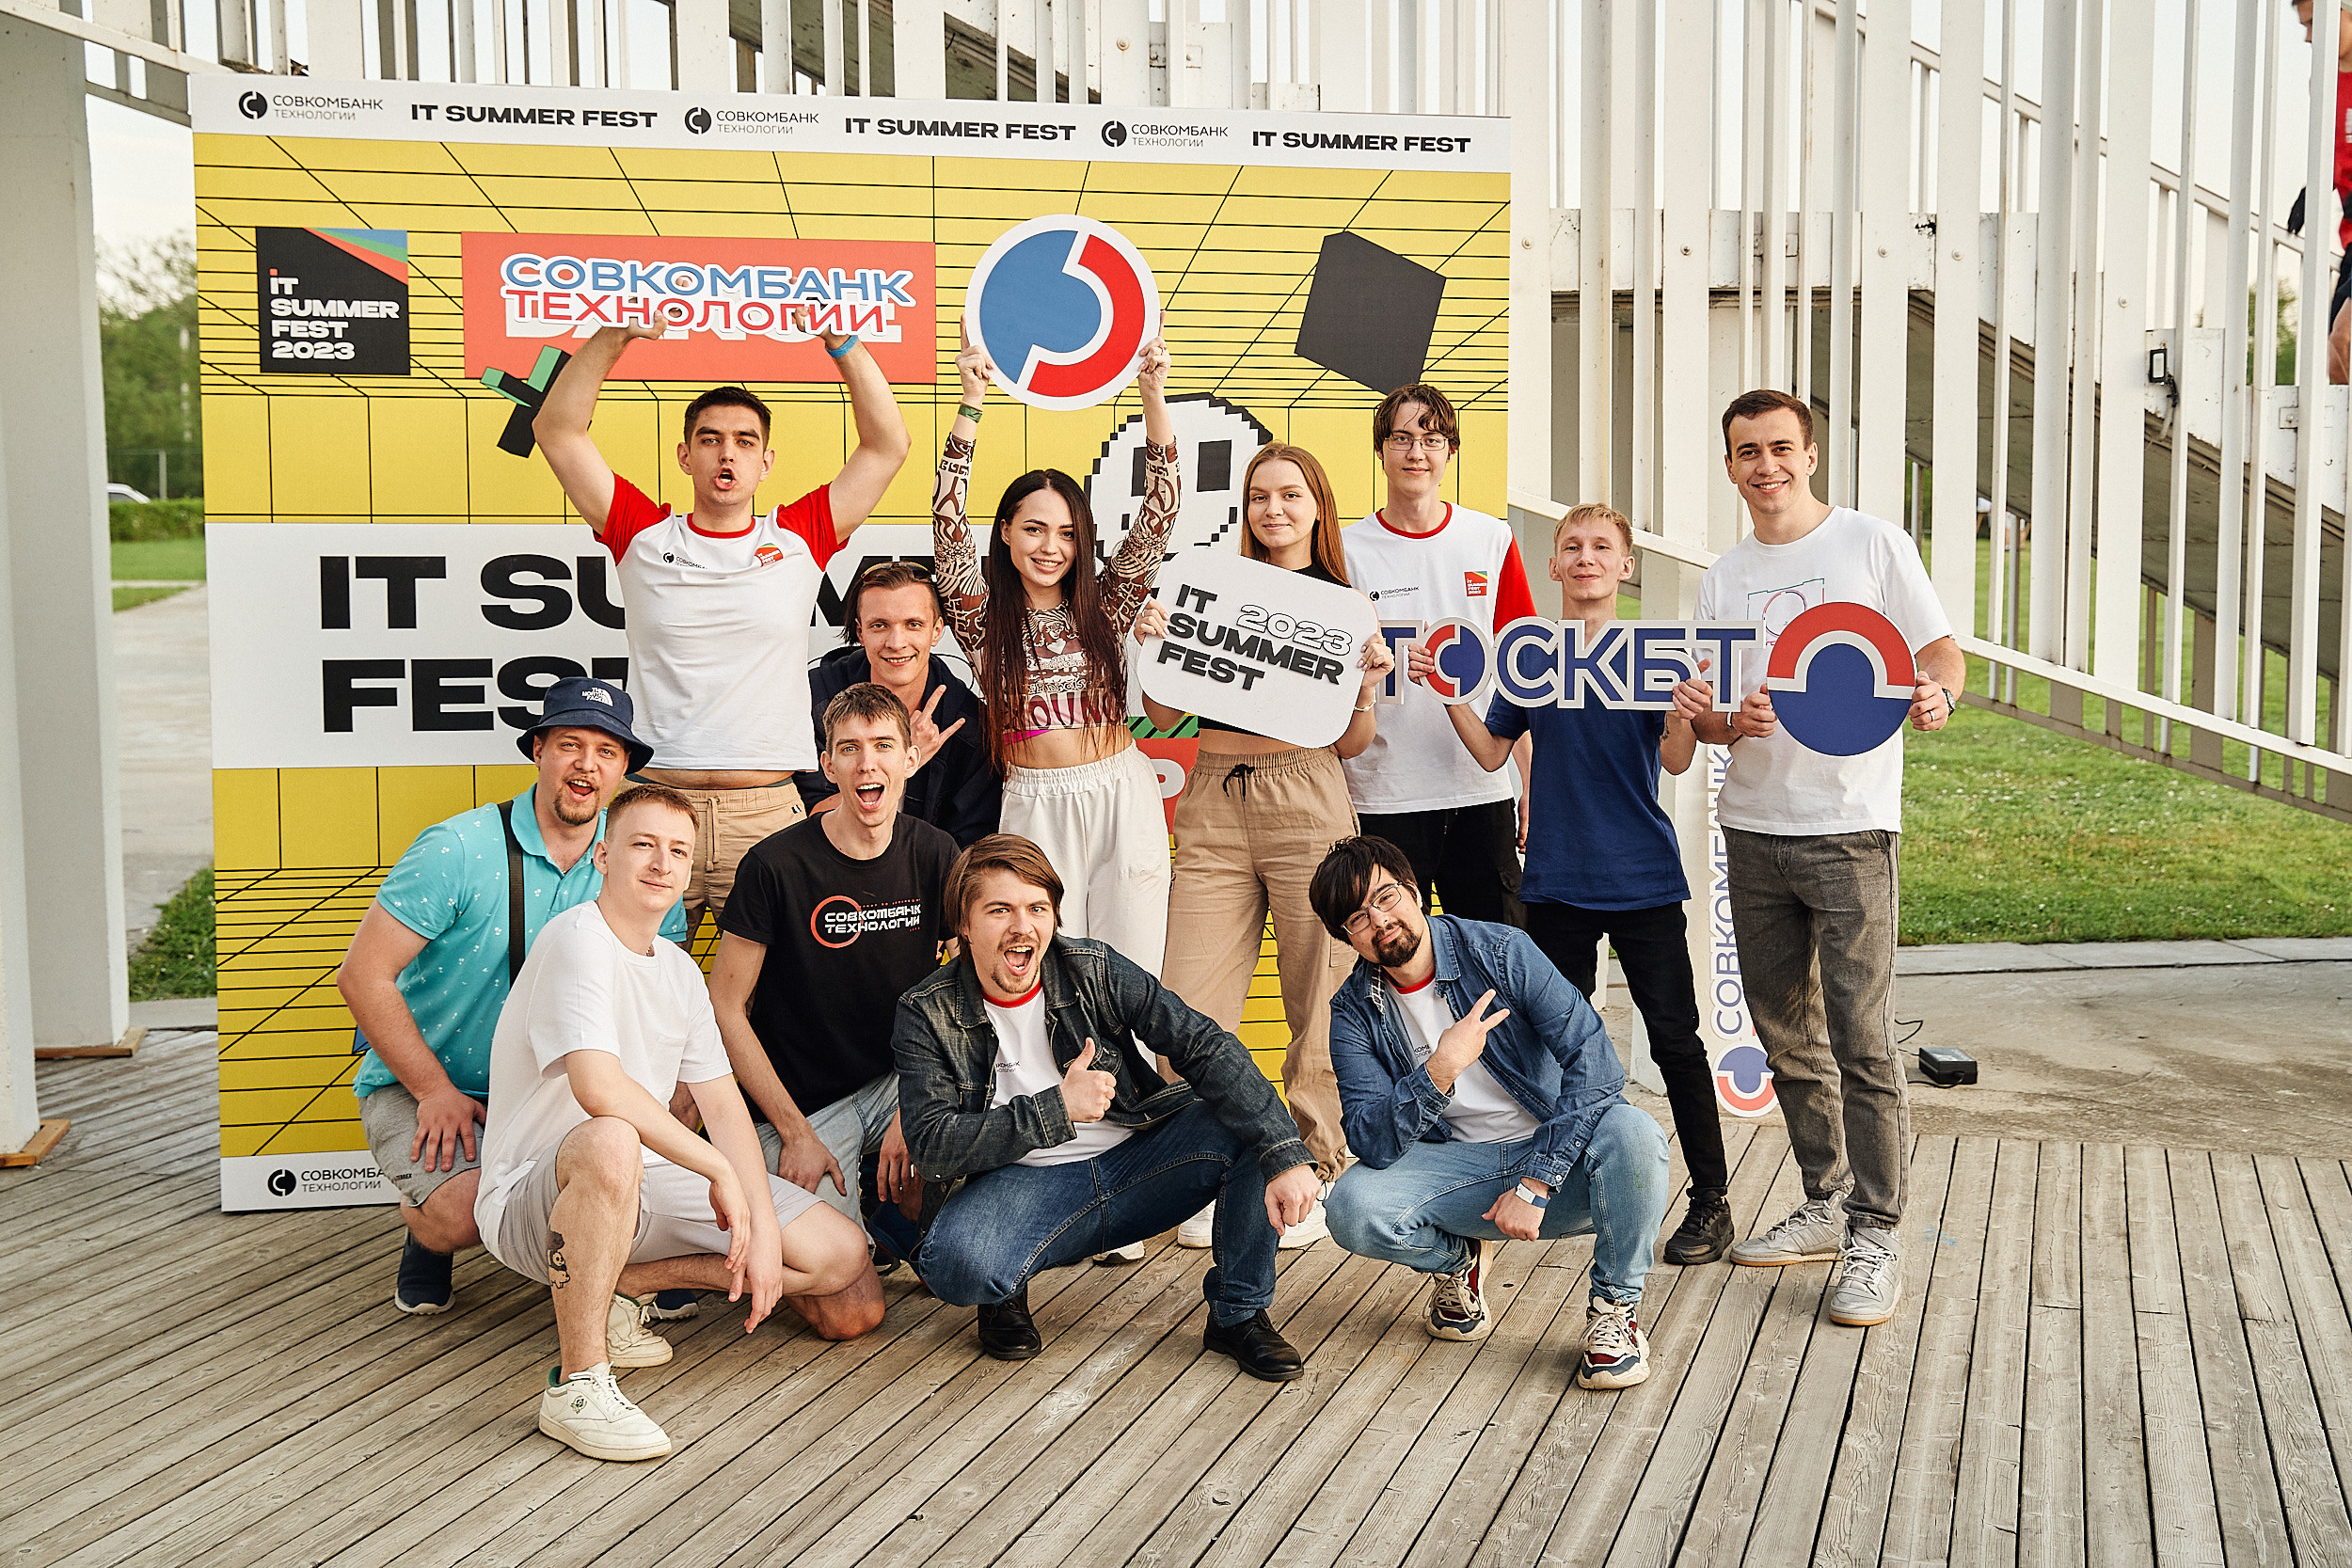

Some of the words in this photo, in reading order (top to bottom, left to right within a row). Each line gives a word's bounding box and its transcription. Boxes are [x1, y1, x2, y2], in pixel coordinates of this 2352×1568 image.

[273, 94, 383, 111] СОВКОМБАНК
[274, 109, 356, 121] ТЕХНОЛОГИИ
[411, 103, 438, 121] IT
[445, 105, 575, 125] SUMMER
[582, 110, 658, 129] FEST
[716, 110, 819, 124] СОВКОМБАНК
[717, 123, 793, 135] ТЕХНОЛОГИИ
[846, 118, 871, 134] IT
[877, 119, 998, 138] SUMMER
[1006, 123, 1076, 141] FEST
[1131, 123, 1228, 137] СОВКОМБАНК
[1132, 136, 1203, 148] ТЕХНОЛОГИИ
[1252, 131, 1277, 147] IT
[1283, 132, 1397, 151] SUMMER
[1404, 136, 1470, 153] FEST
[506, 257, 912, 303] СОВКОМБАНК
[270, 298, 400, 319] SUMMER
[506, 289, 884, 333] ТЕХНОЛОГИИ
[271, 320, 349, 339] FEST
[272, 341, 356, 360] 2023
[320, 556, 447, 629] IT
[1176, 584, 1217, 613] IT
[1236, 604, 1353, 656] 2023
[1168, 612, 1344, 685] SUMMER
[1157, 641, 1265, 690] FEST
[825, 904, 922, 923] СОВКОМБАНК
[825, 914, 920, 934] ТЕХНОЛОГИИ
[302, 1180, 381, 1193] ТЕХНОЛОГИИ
